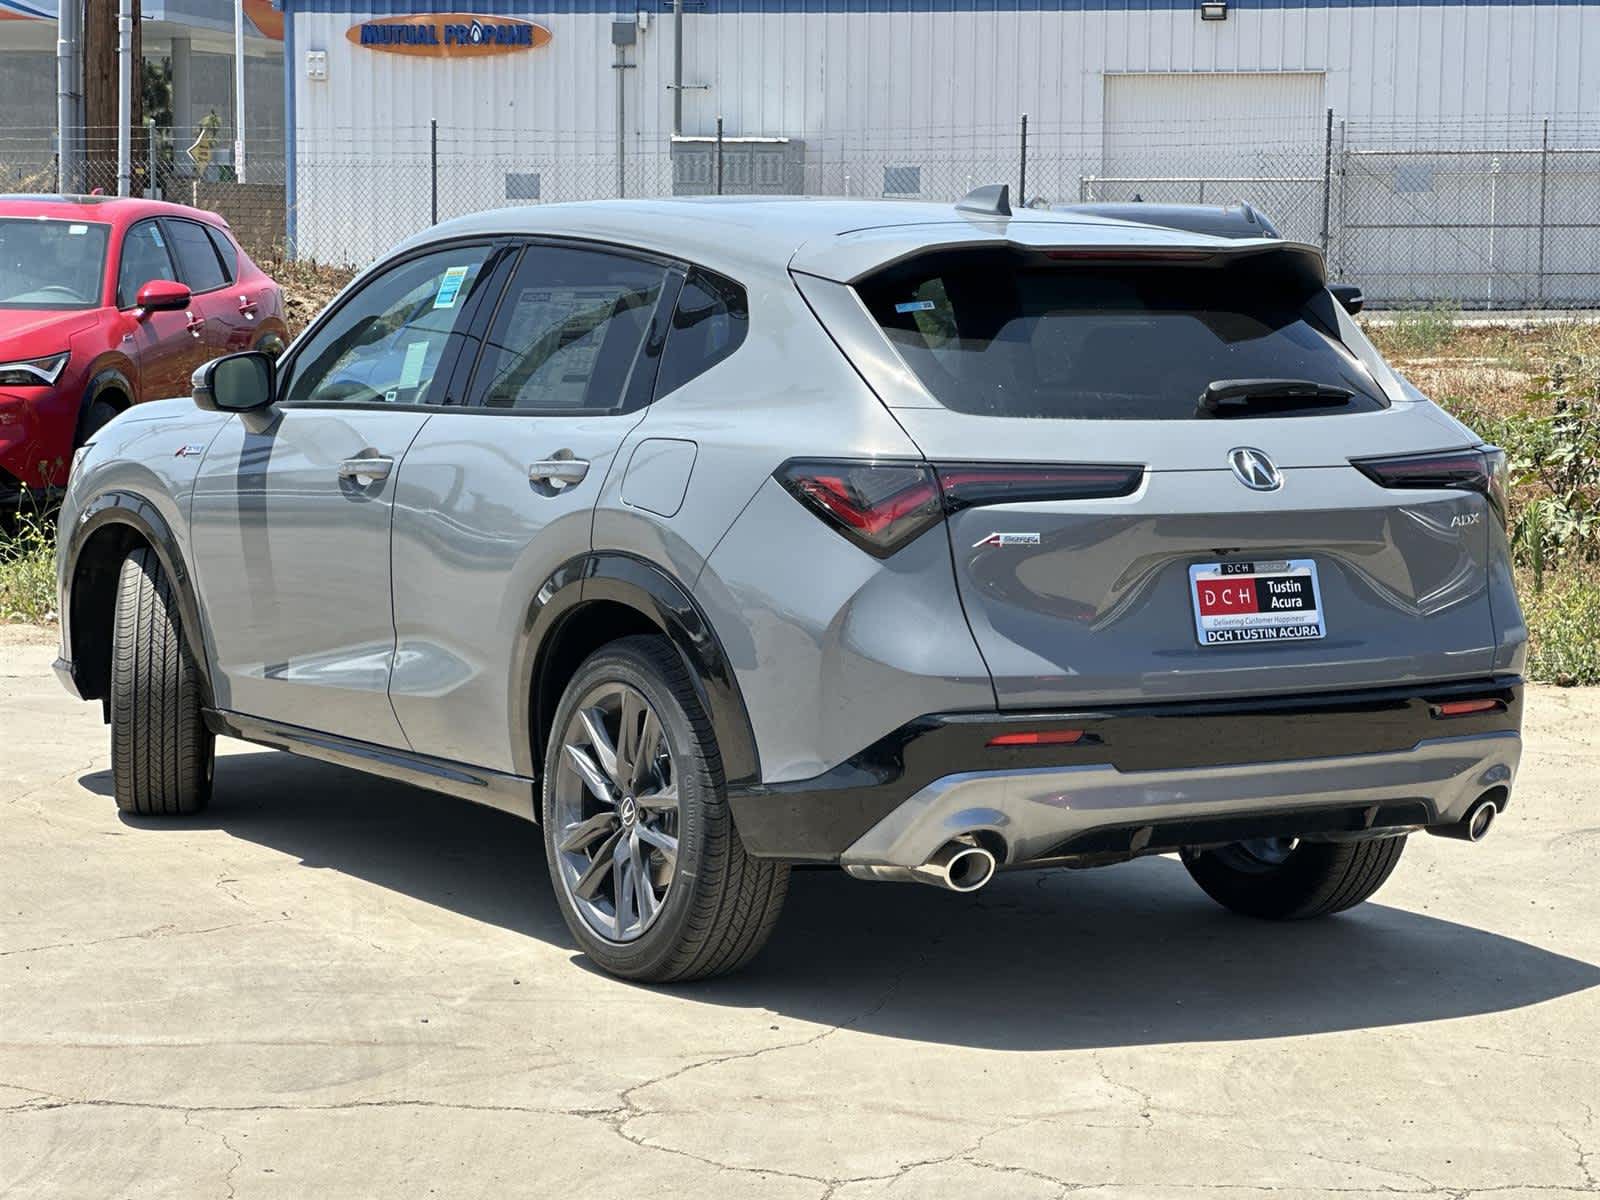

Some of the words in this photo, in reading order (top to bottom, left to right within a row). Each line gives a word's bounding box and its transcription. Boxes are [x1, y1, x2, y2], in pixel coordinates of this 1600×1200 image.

[360, 24, 439, 45] MUTUAL
[444, 19, 533, 46] PROPANE
[1450, 512, 1479, 528] ADX
[1227, 564, 1249, 573] DCH
[1267, 580, 1302, 594] Tustin
[1271, 597, 1303, 609] Acura
[1207, 630, 1233, 642] DCH
[1235, 627, 1278, 640] TUSTIN
[1279, 625, 1319, 637] ACURA
